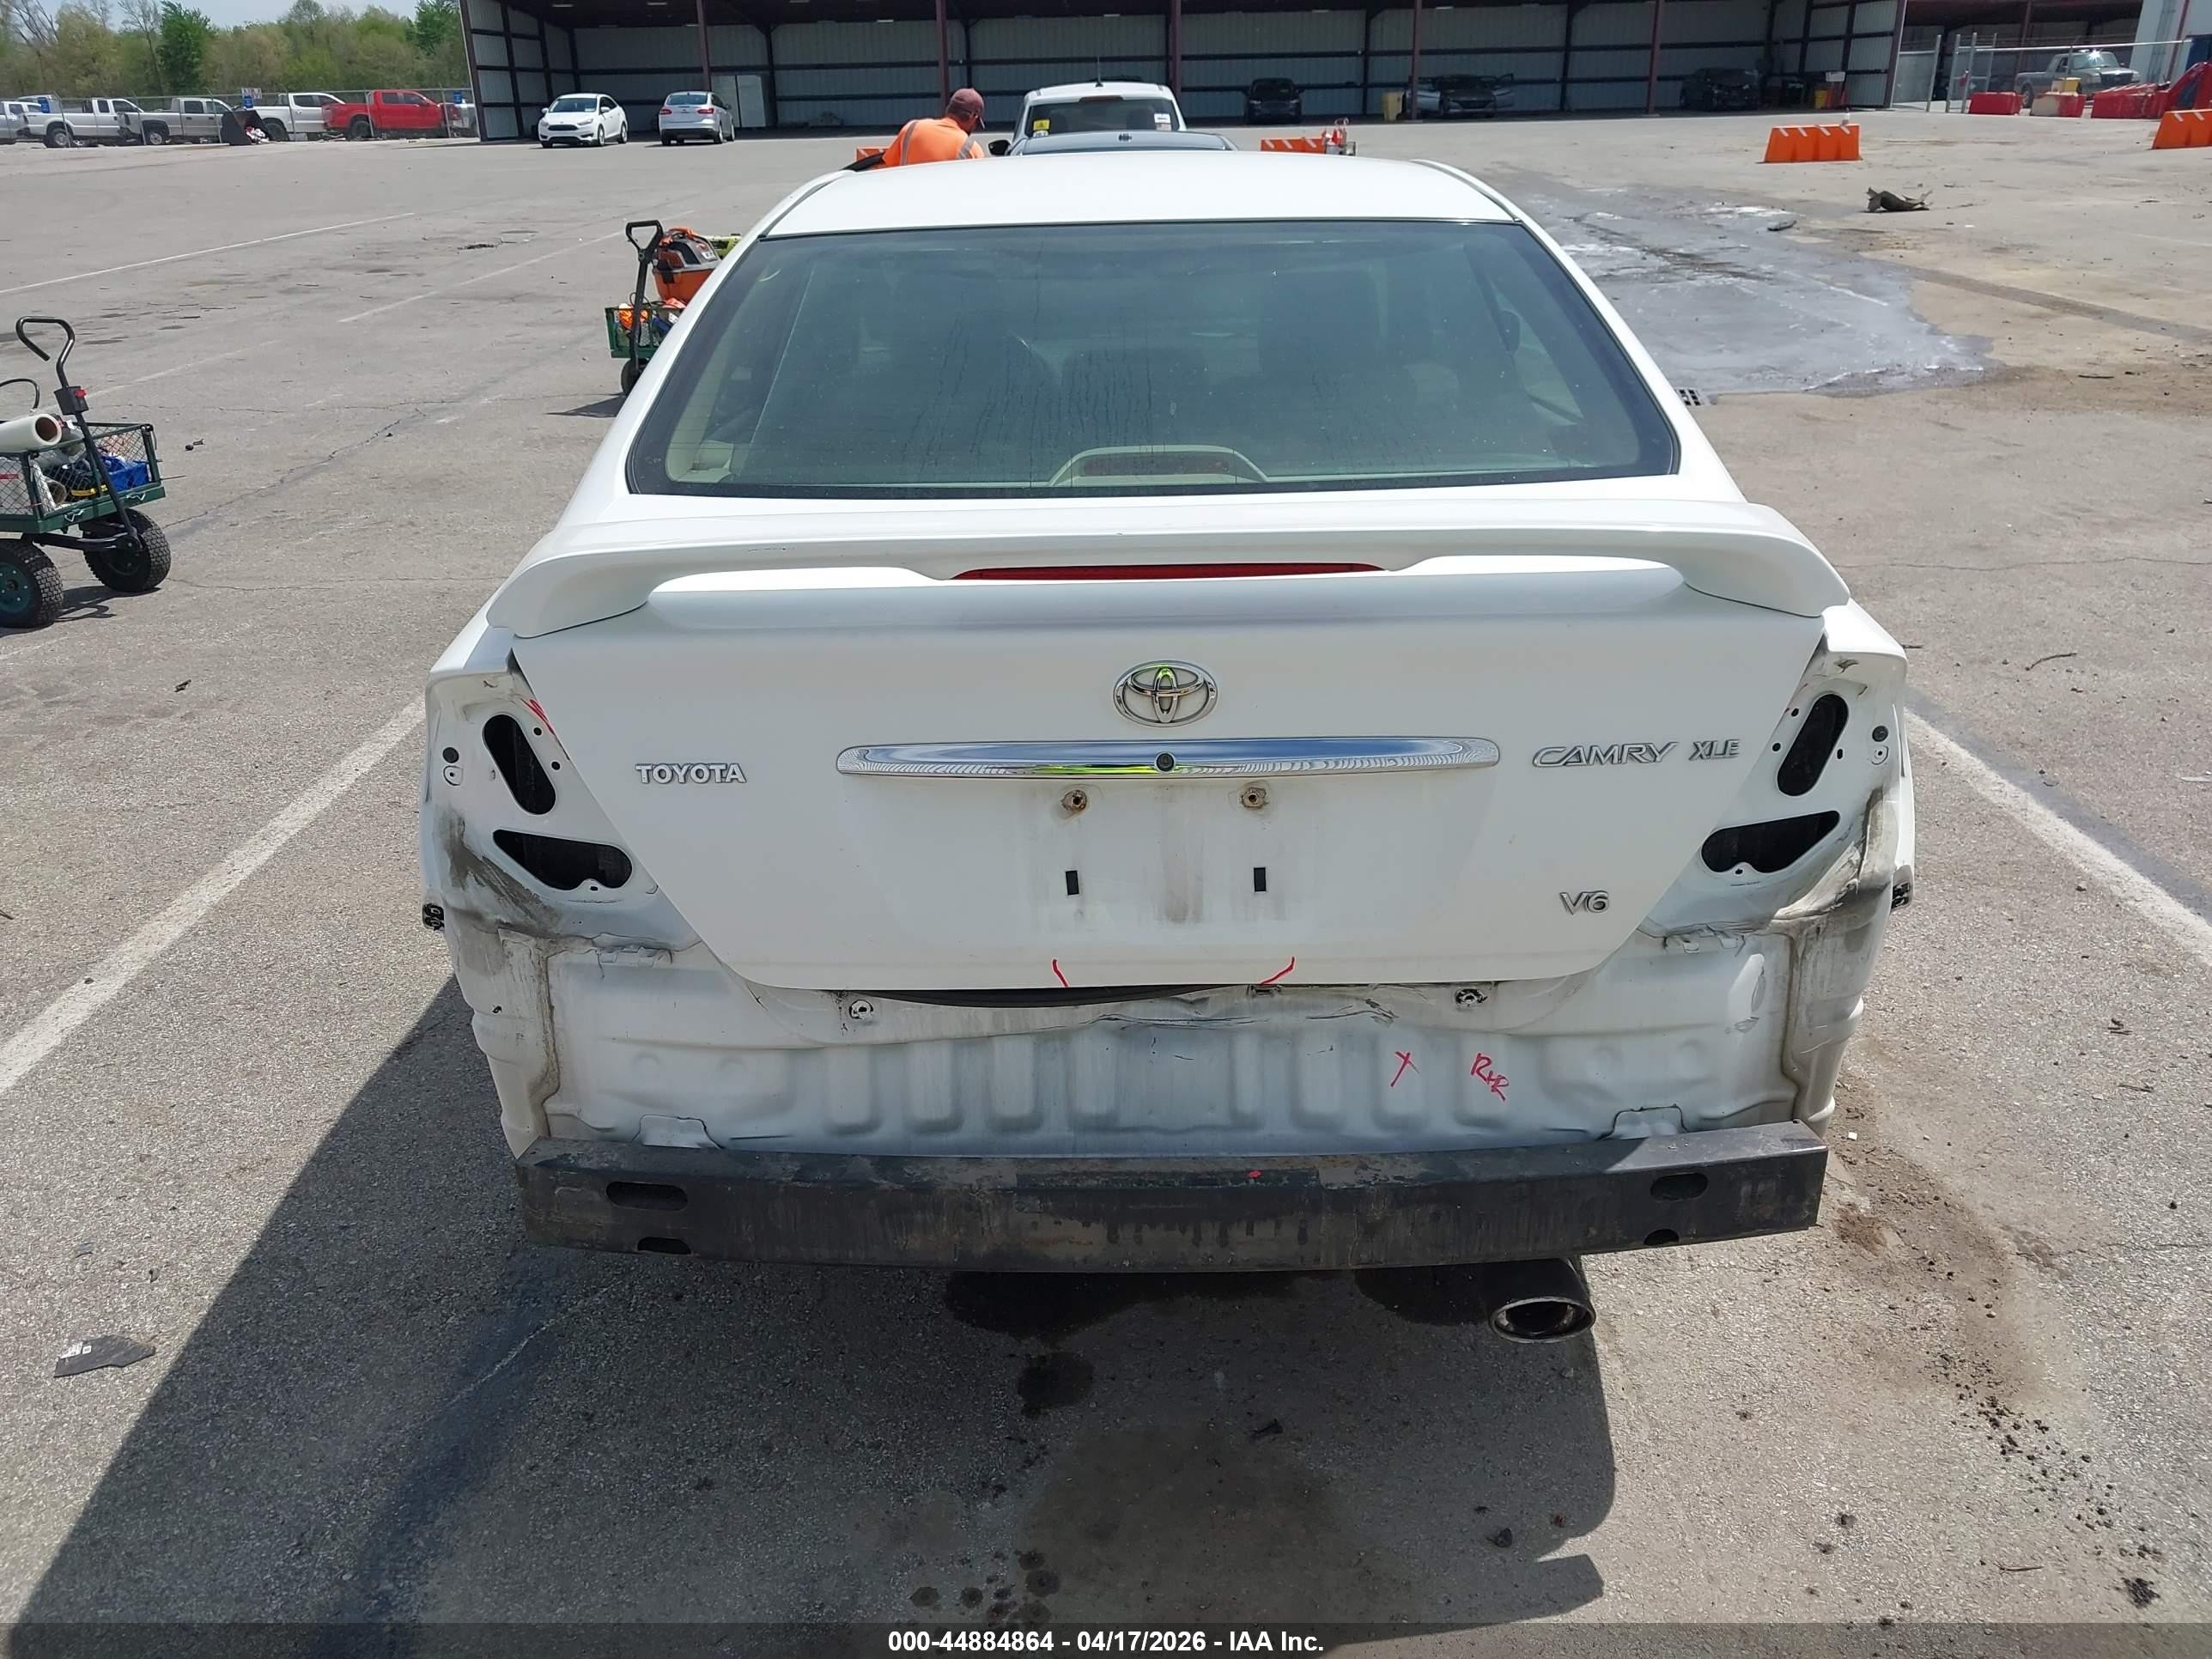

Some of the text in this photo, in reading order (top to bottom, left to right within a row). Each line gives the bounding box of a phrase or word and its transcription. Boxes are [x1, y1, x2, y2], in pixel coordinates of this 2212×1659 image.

[1532, 738, 1741, 767] CAMRY XLE
[635, 763, 747, 784] TOYOTA
[1559, 890, 1609, 915] V6
